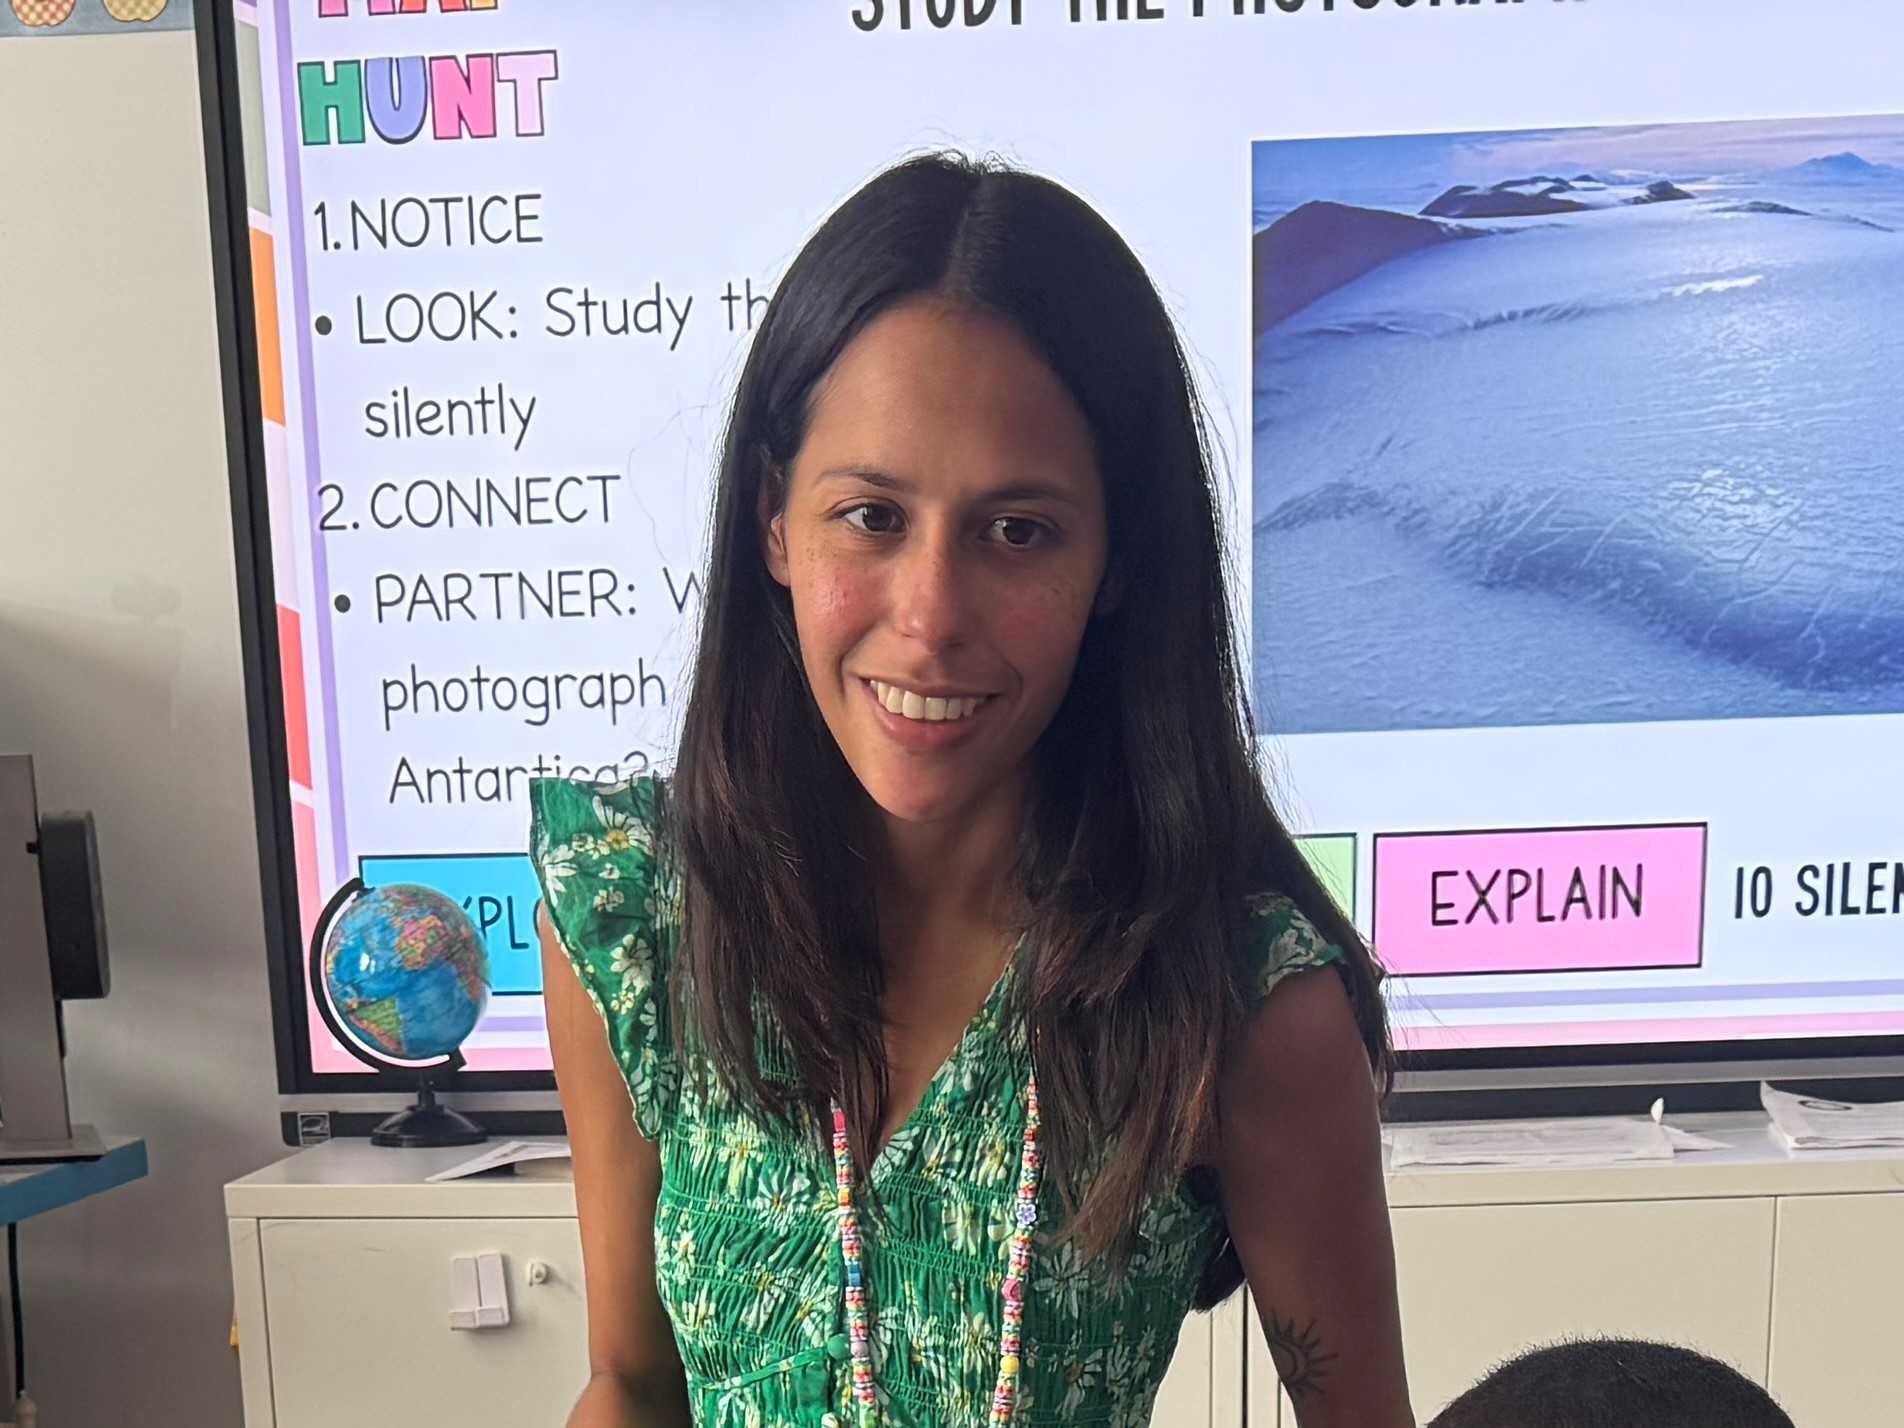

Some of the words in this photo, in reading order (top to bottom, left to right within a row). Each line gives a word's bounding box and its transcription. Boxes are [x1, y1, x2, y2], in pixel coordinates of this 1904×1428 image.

[297, 50, 558, 145] HUNT
[357, 289, 518, 344] LOOK:
[545, 281, 694, 352] Study
[720, 277, 770, 332] th
[364, 382, 537, 451] silently
[375, 567, 637, 624] PARTNER:
[382, 656, 667, 730] photograph
[1431, 863, 1644, 927] EXPLAIN
[1734, 865, 1773, 920] 10
